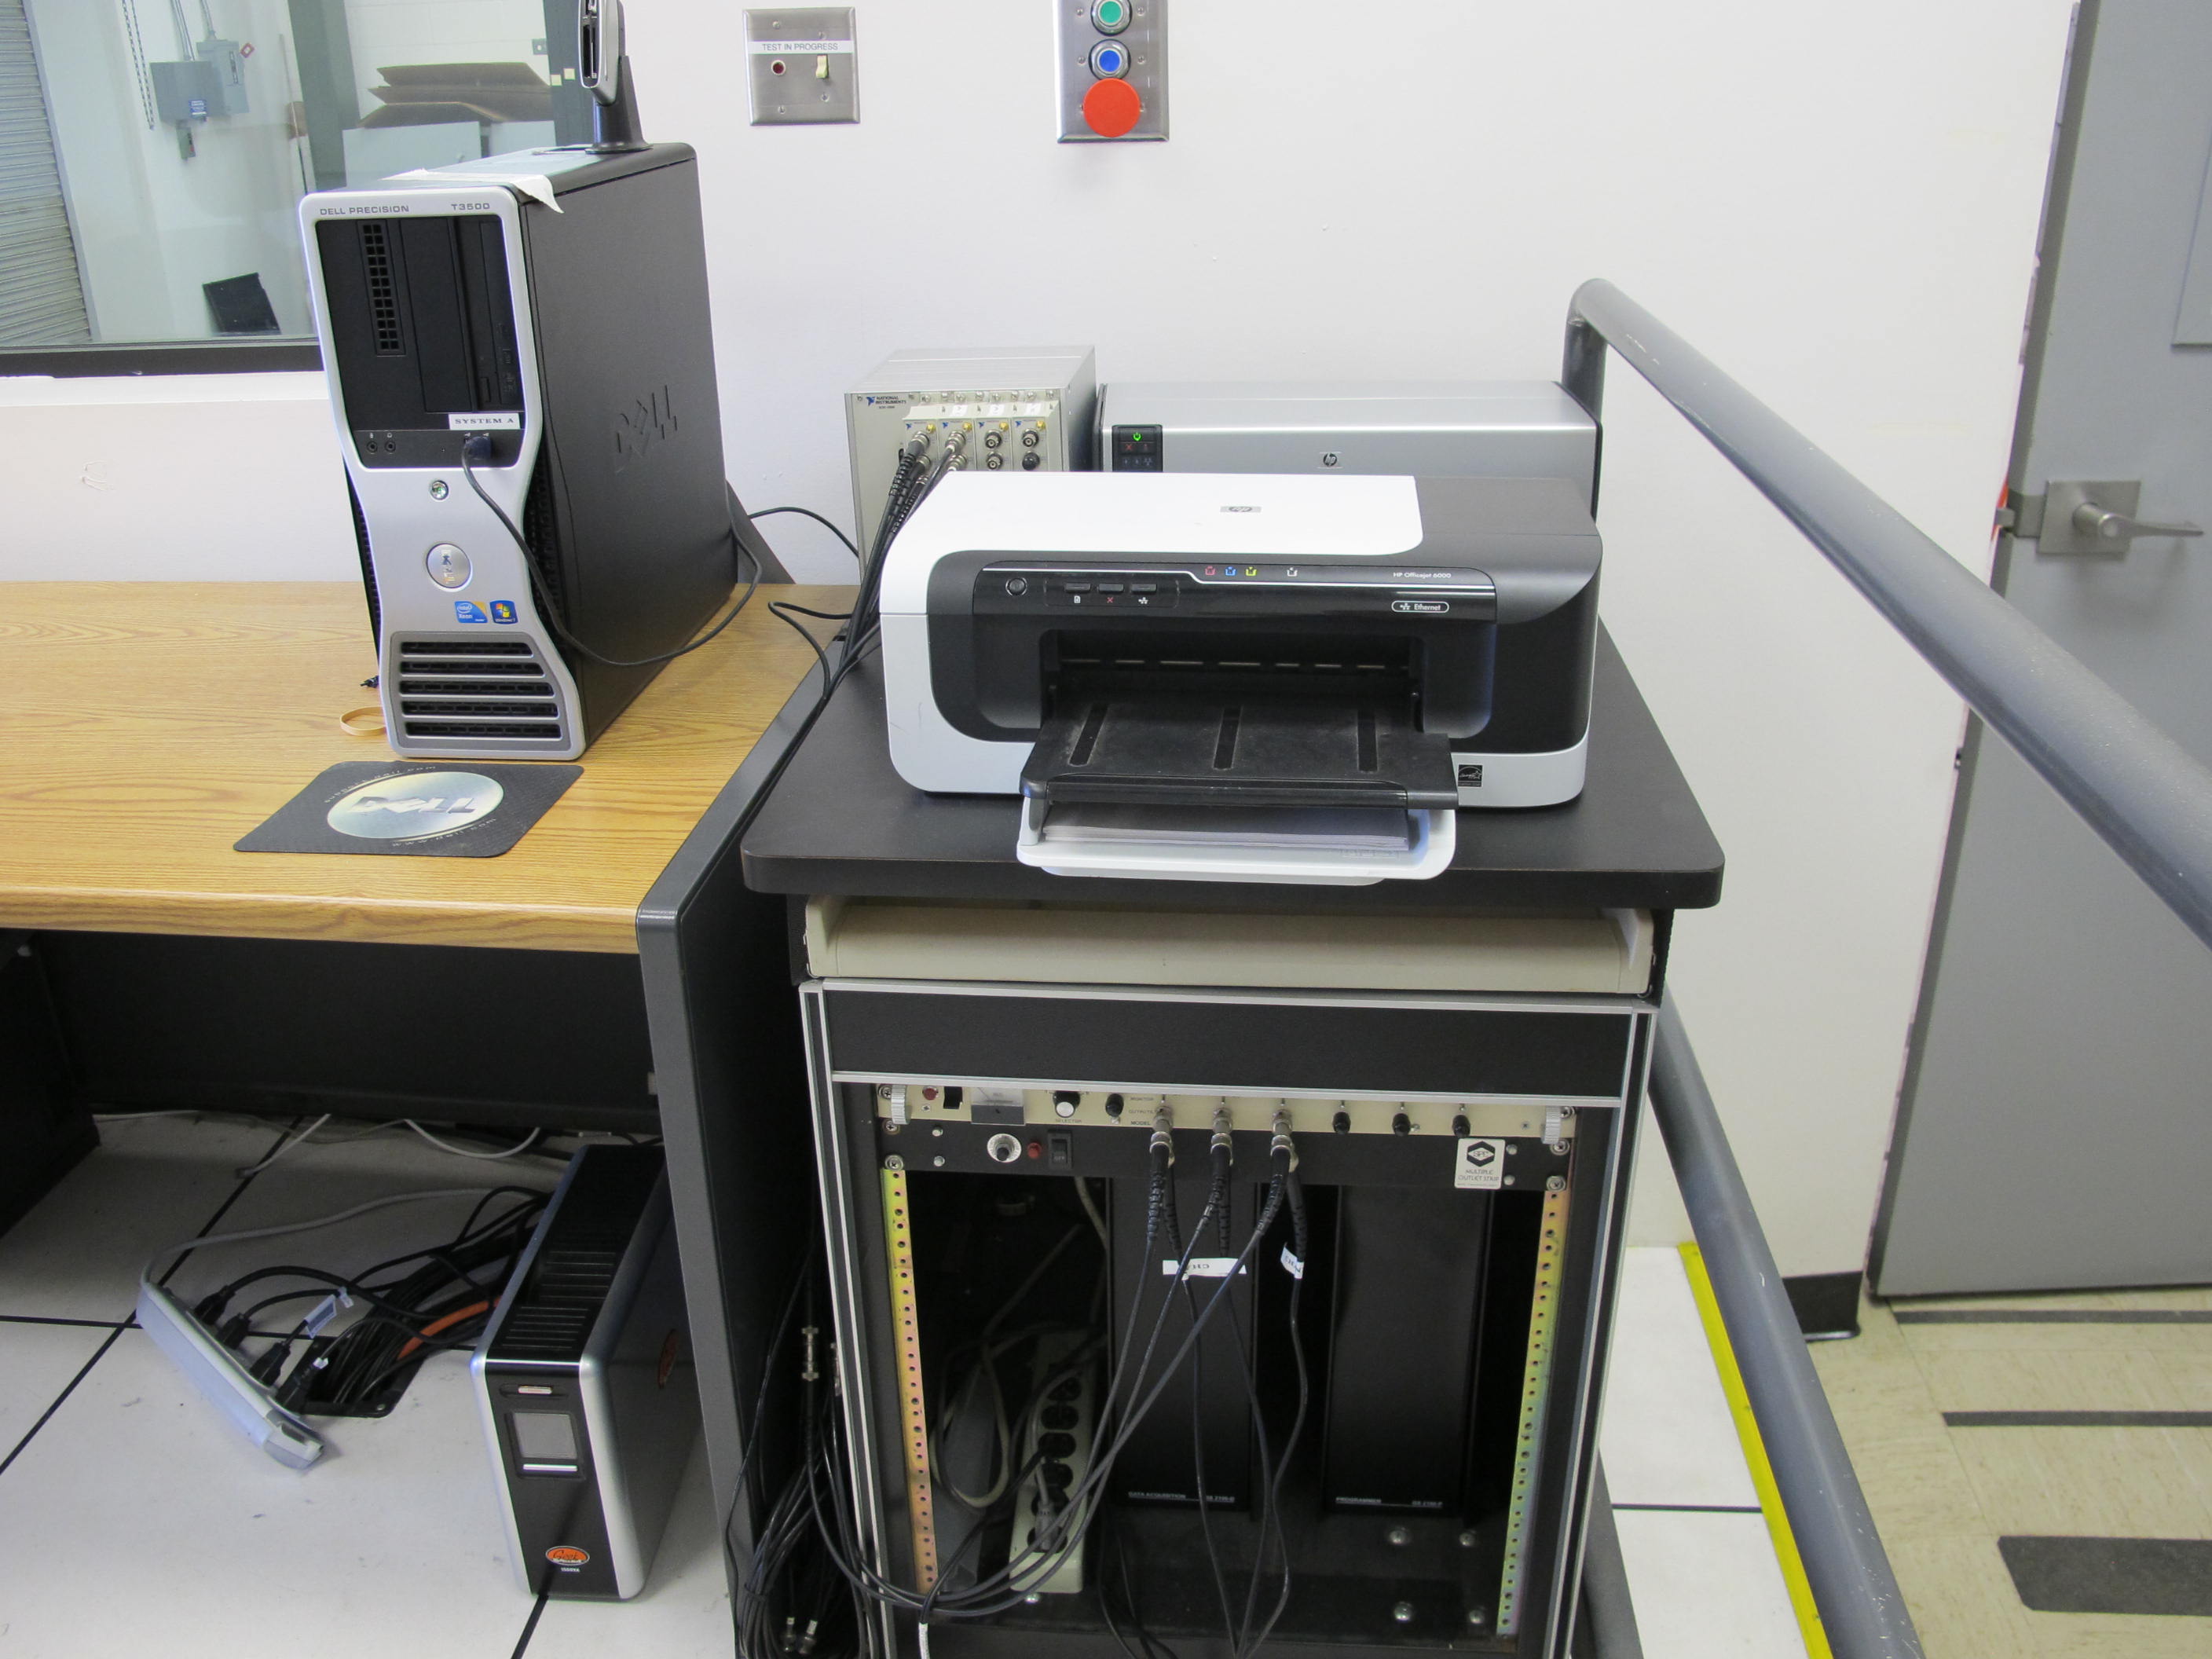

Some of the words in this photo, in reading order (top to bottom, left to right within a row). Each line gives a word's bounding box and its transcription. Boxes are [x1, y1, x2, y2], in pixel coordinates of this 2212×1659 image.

[794, 42, 839, 51] PROGRESS
[349, 205, 409, 214] PRECISION
[451, 203, 490, 211] T3500
[347, 796, 476, 814] DELL
